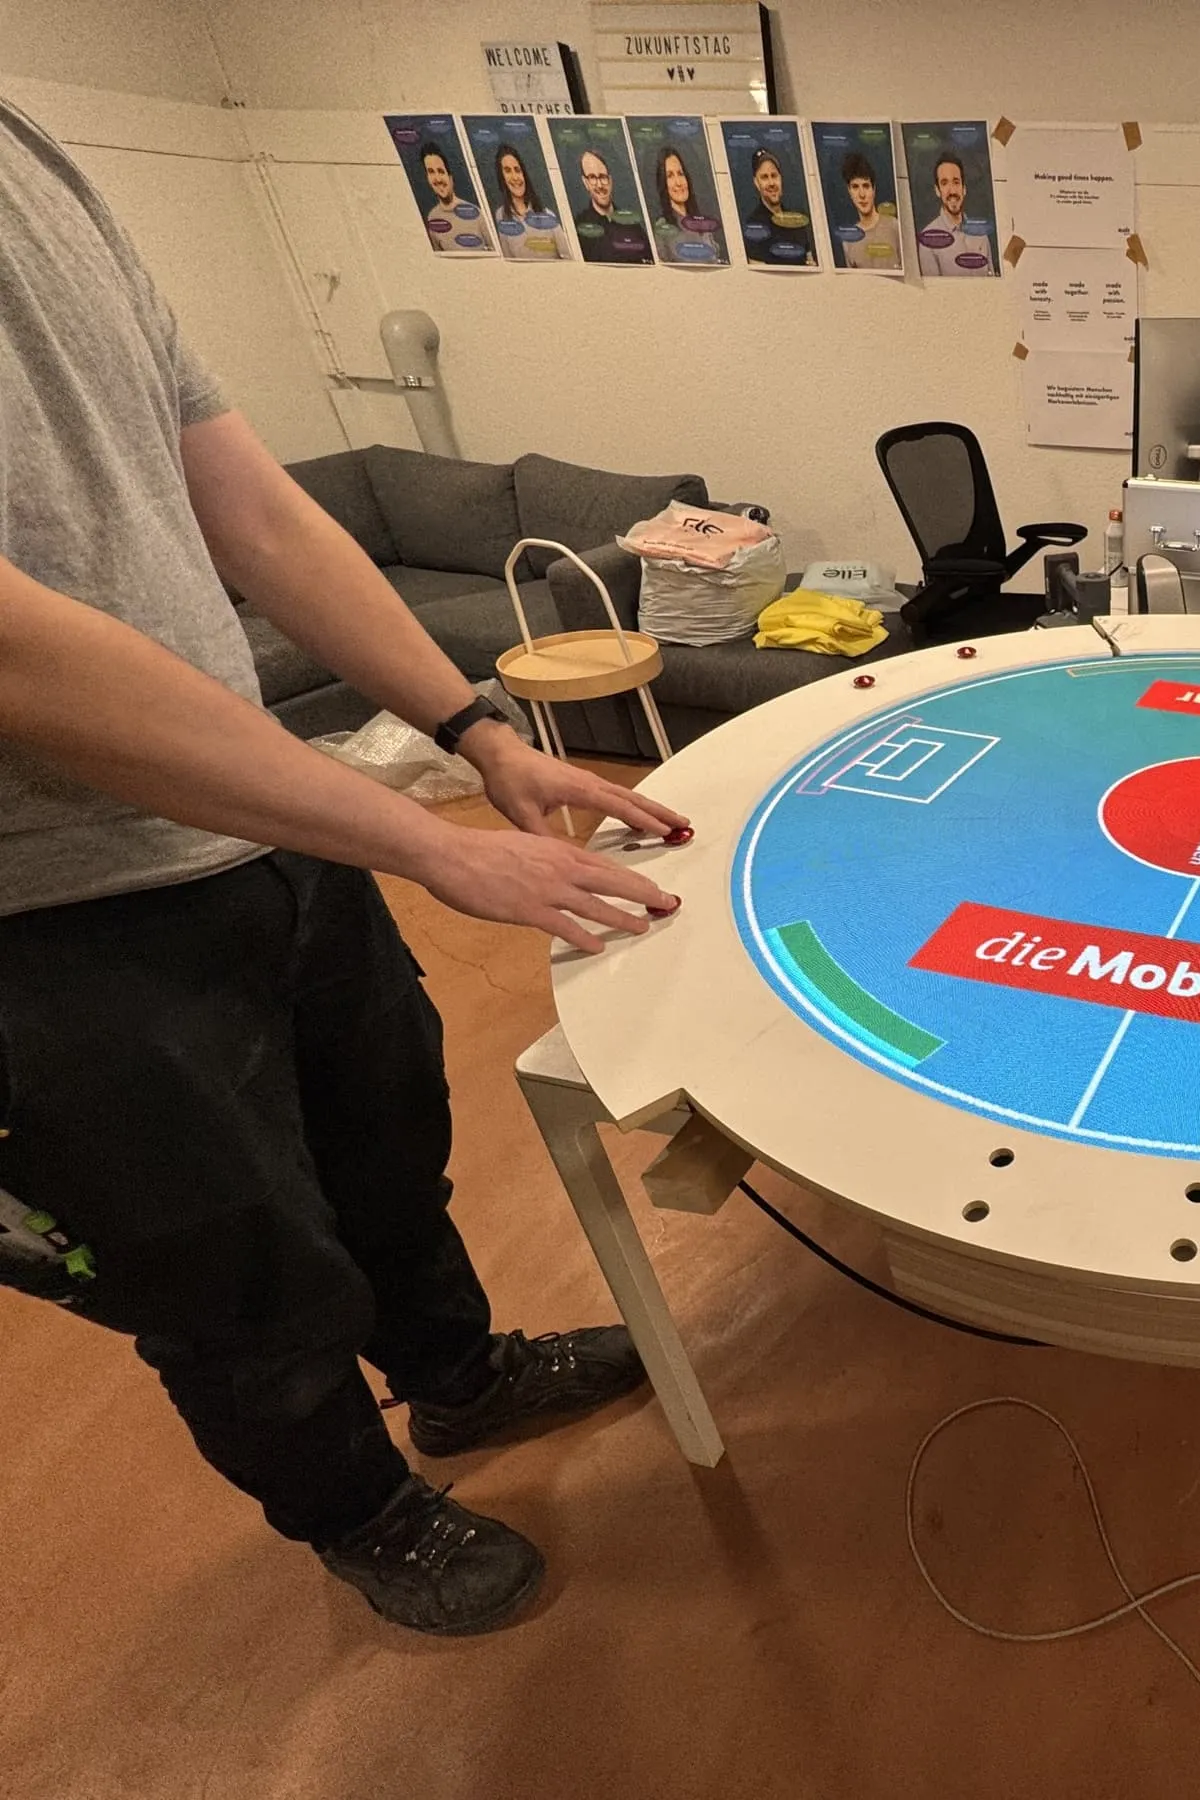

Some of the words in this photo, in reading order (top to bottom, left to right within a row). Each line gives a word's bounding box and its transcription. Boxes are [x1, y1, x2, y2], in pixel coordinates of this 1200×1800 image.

[625, 35, 731, 55] ZUKUNFTSTAG
[485, 47, 551, 66] WELCOME
[1034, 173, 1056, 182] Making
[1057, 173, 1073, 182] good
[822, 569, 867, 580] Elle
[973, 930, 1068, 972] die
